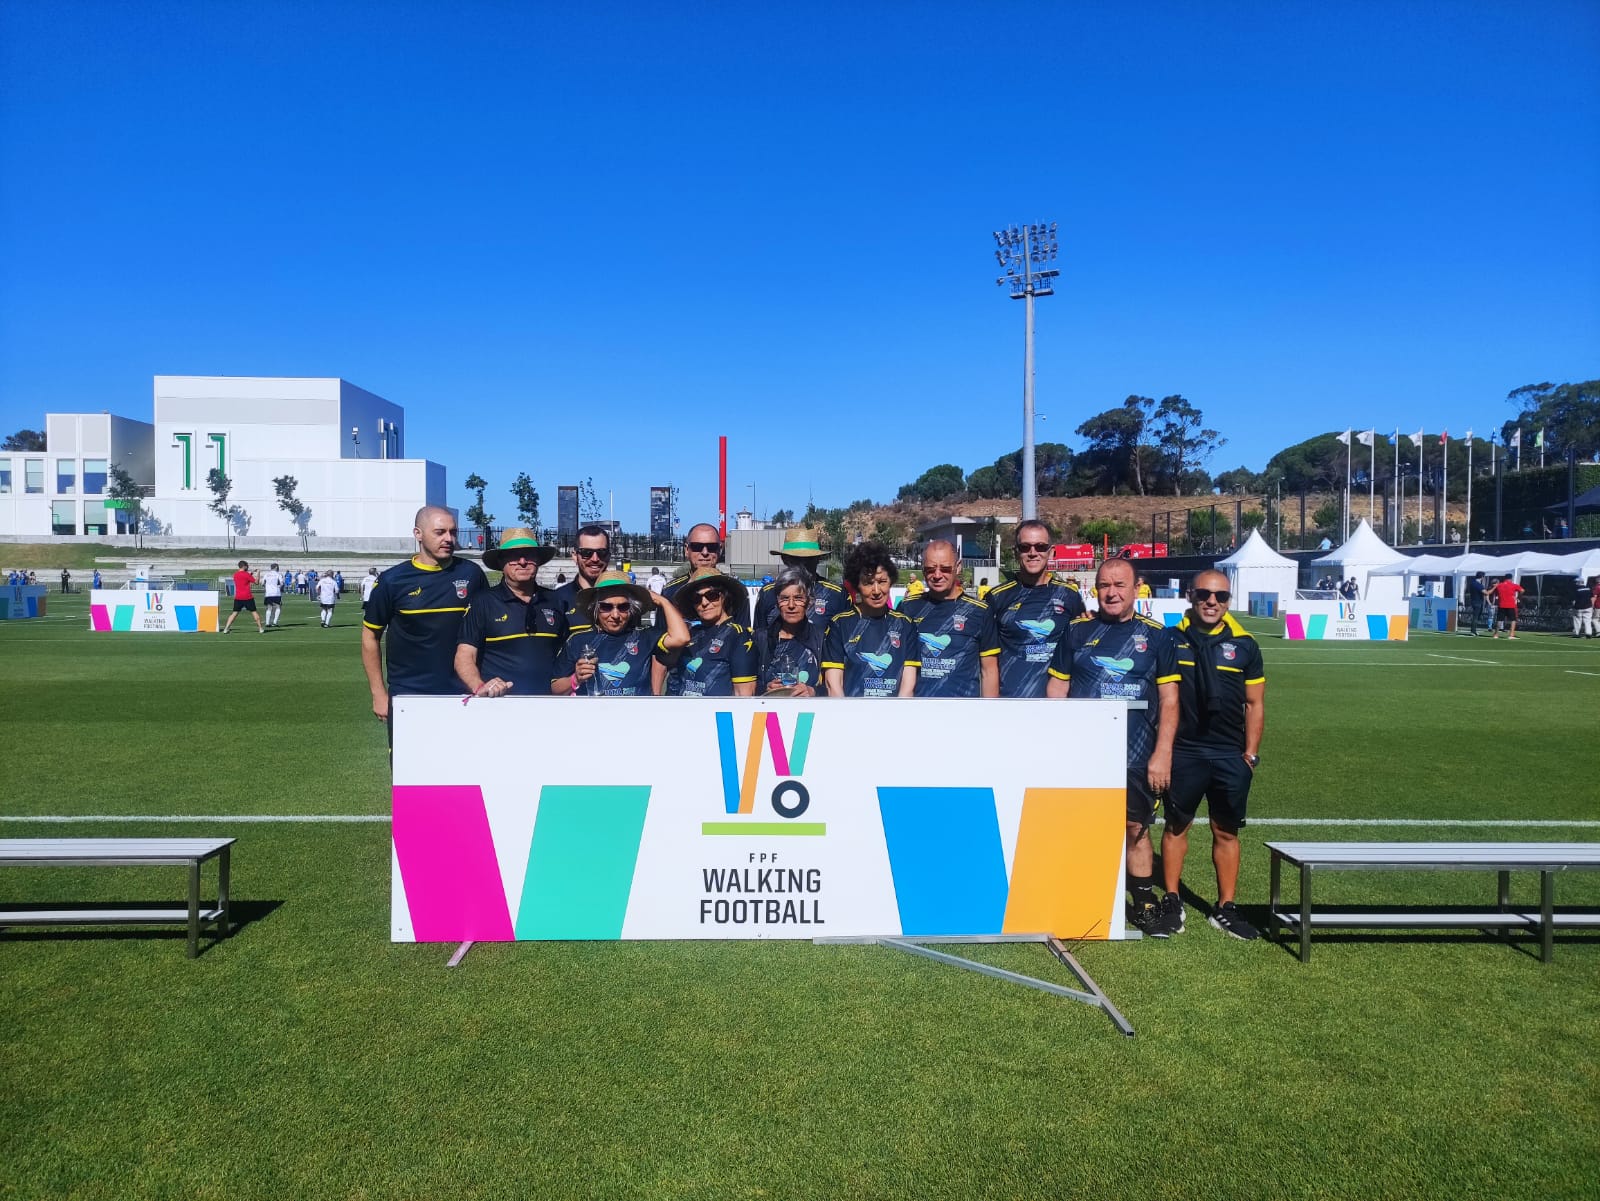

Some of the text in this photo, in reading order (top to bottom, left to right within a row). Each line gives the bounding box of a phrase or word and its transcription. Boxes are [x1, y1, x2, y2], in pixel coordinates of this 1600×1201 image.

[171, 431, 231, 490] 11
[749, 852, 778, 863] FPF
[702, 868, 821, 893] WALKING
[700, 899, 825, 924] FOOTBALL
